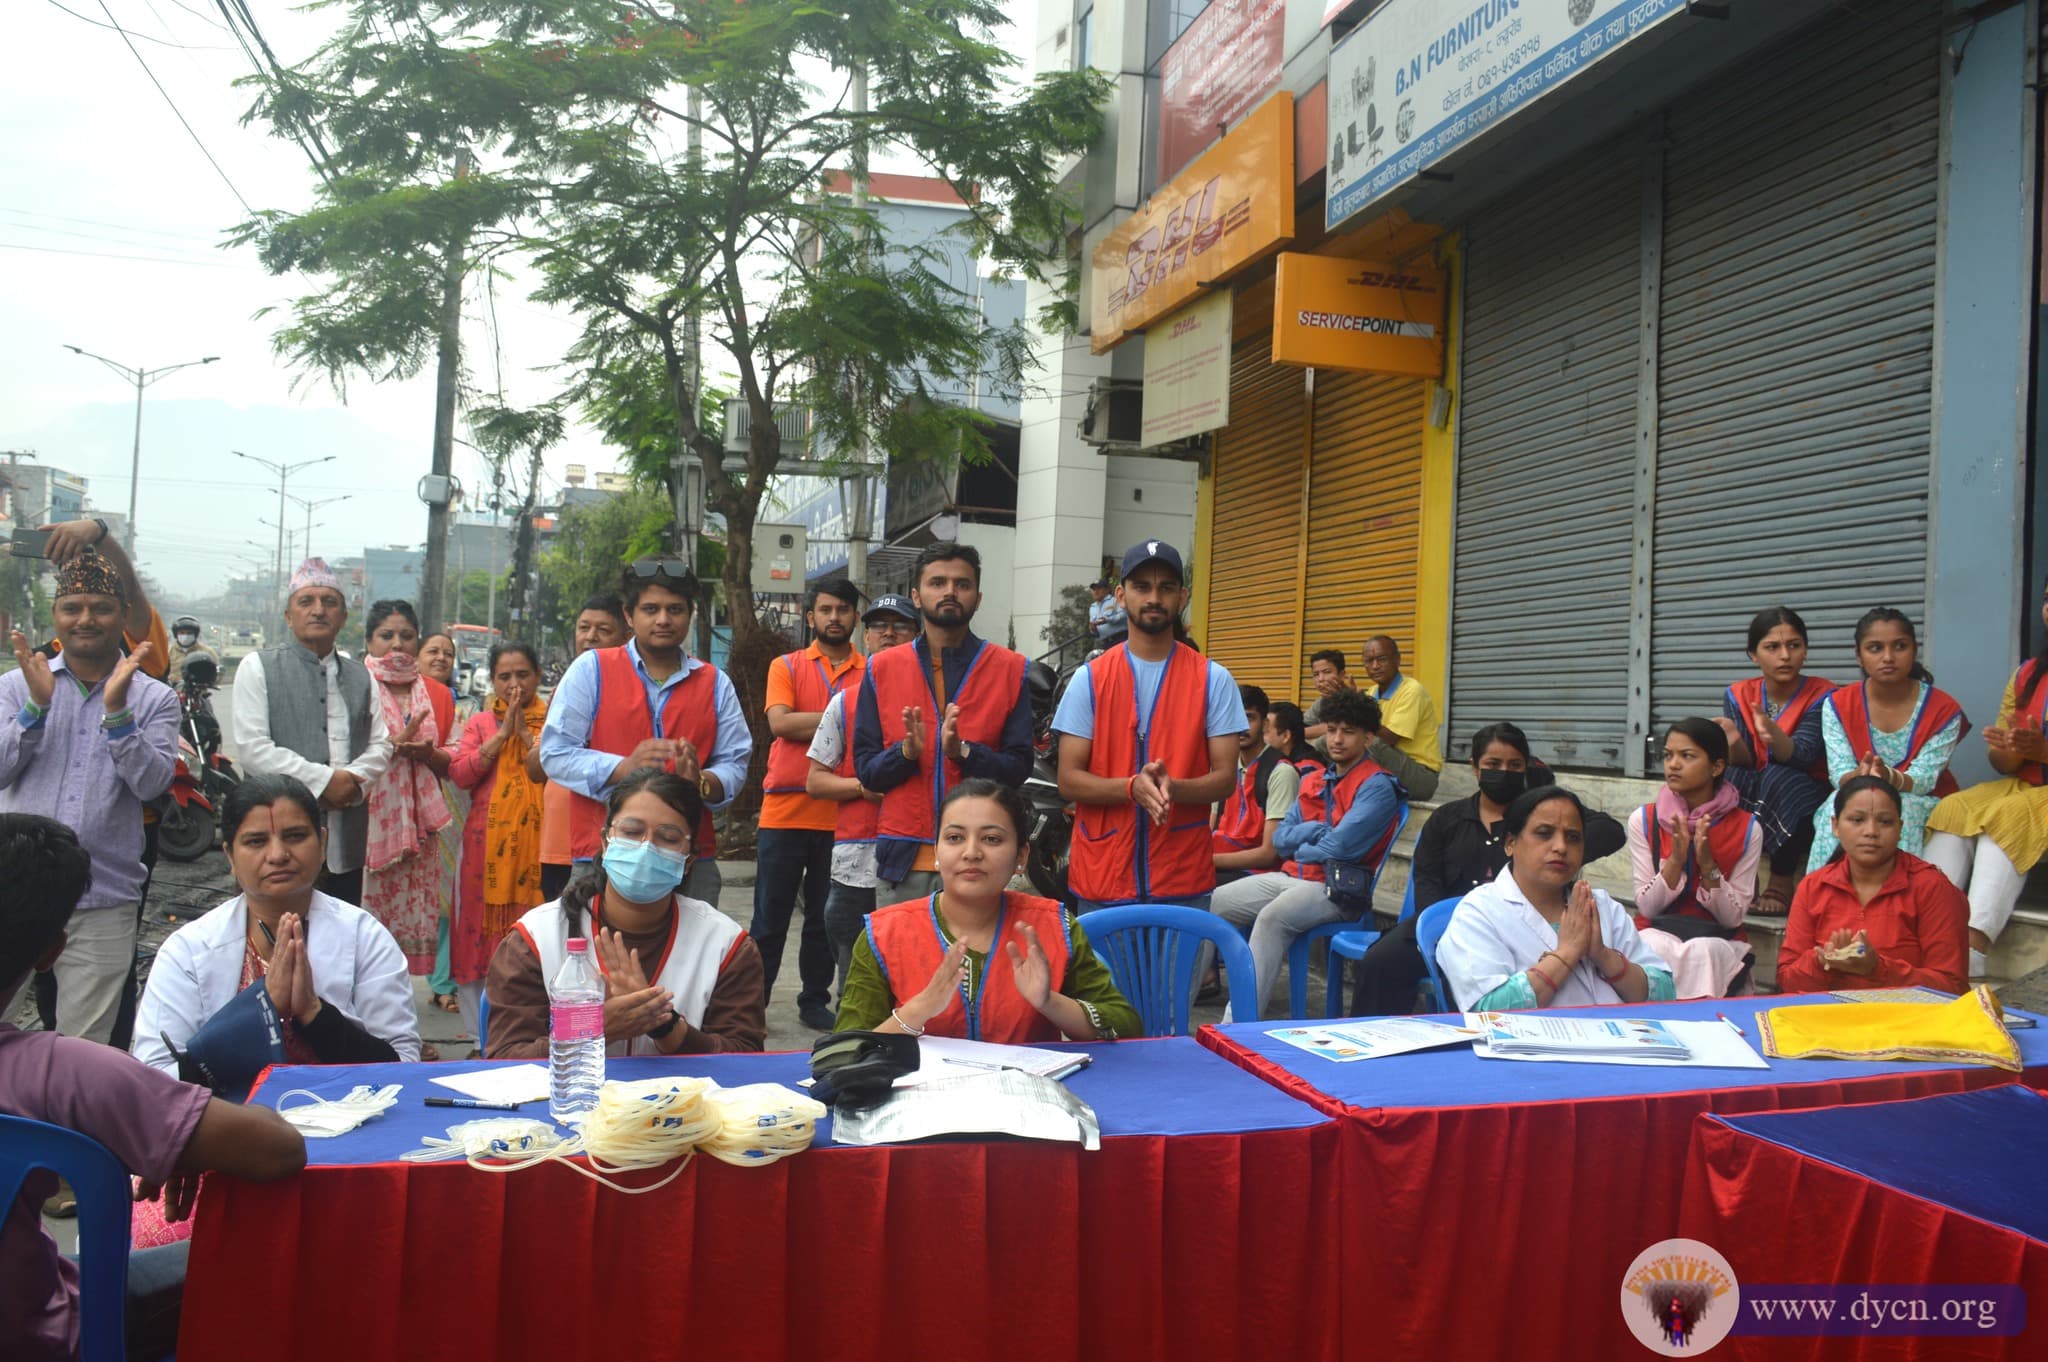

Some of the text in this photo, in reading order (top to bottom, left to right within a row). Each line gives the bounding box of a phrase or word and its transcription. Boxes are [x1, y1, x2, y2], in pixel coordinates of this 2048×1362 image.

[1580, 29, 1604, 58] थोक
[1605, 15, 1626, 43] तथा
[1395, 54, 1422, 96] B.N
[1442, 88, 1462, 111] फोन
[1124, 174, 1226, 306] DHL
[1360, 271, 1423, 291] DHL
[1299, 310, 1405, 336] SERVICEPOINT
